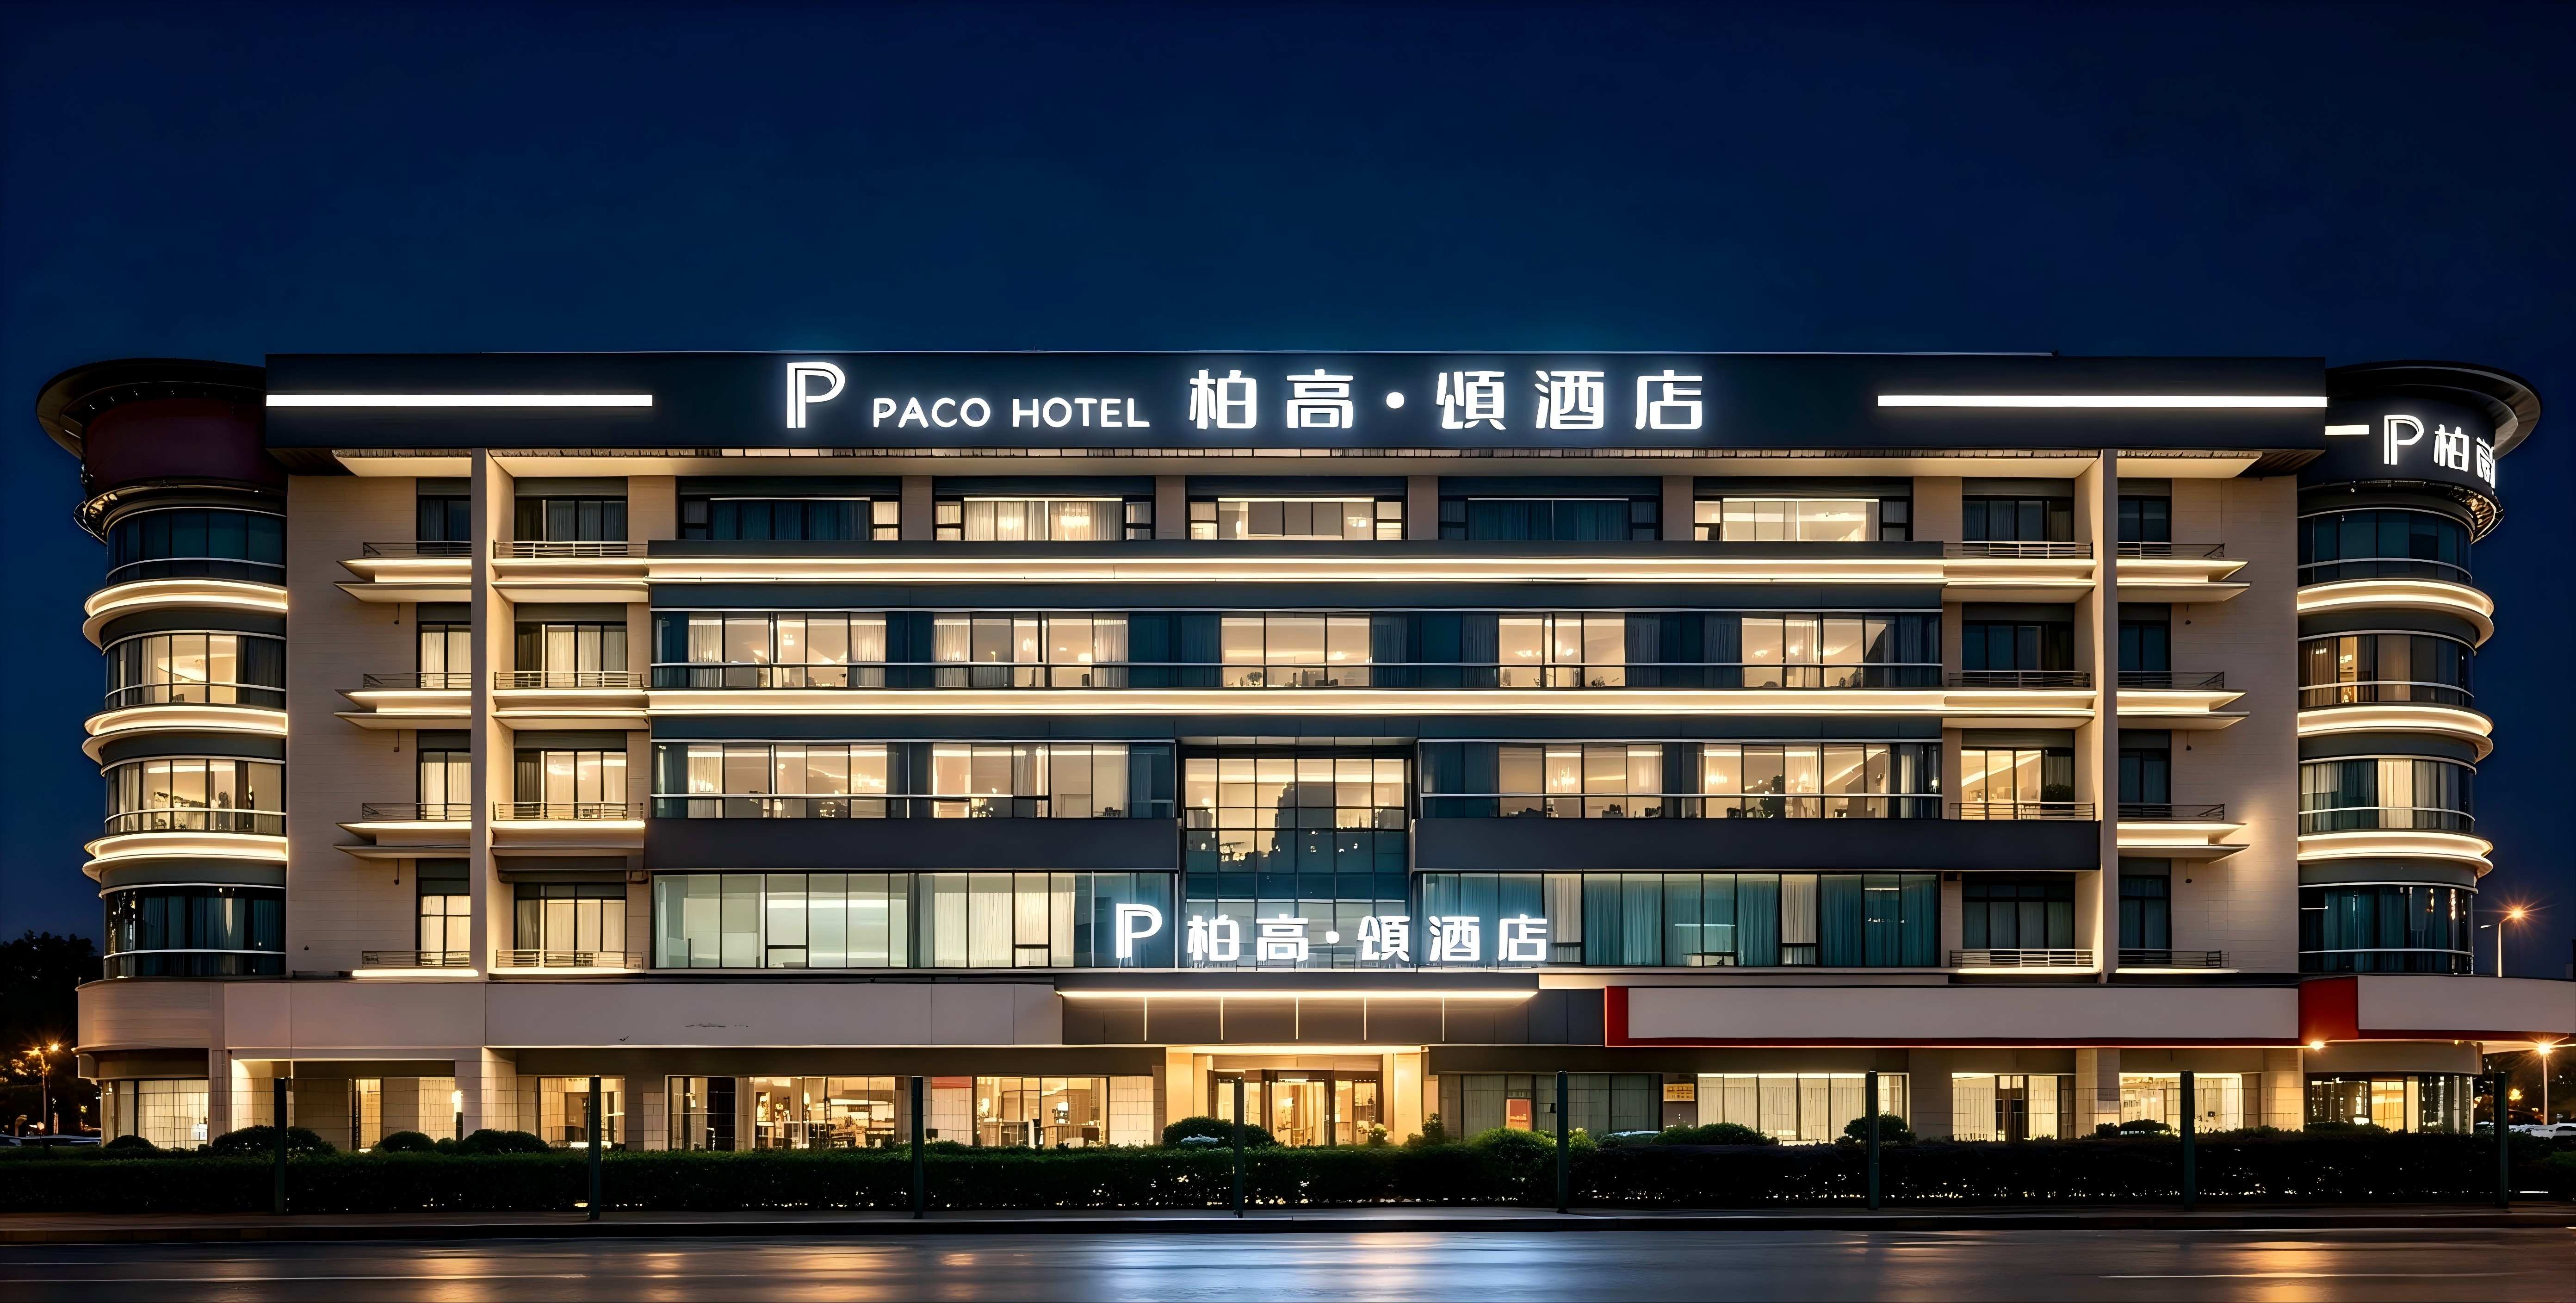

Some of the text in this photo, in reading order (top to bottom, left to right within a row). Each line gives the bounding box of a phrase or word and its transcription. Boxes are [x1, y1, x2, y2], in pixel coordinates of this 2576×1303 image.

[786, 362, 1151, 428] P PACO HOTEL
[2383, 414, 2424, 465] P
[1115, 903, 1163, 958] P
